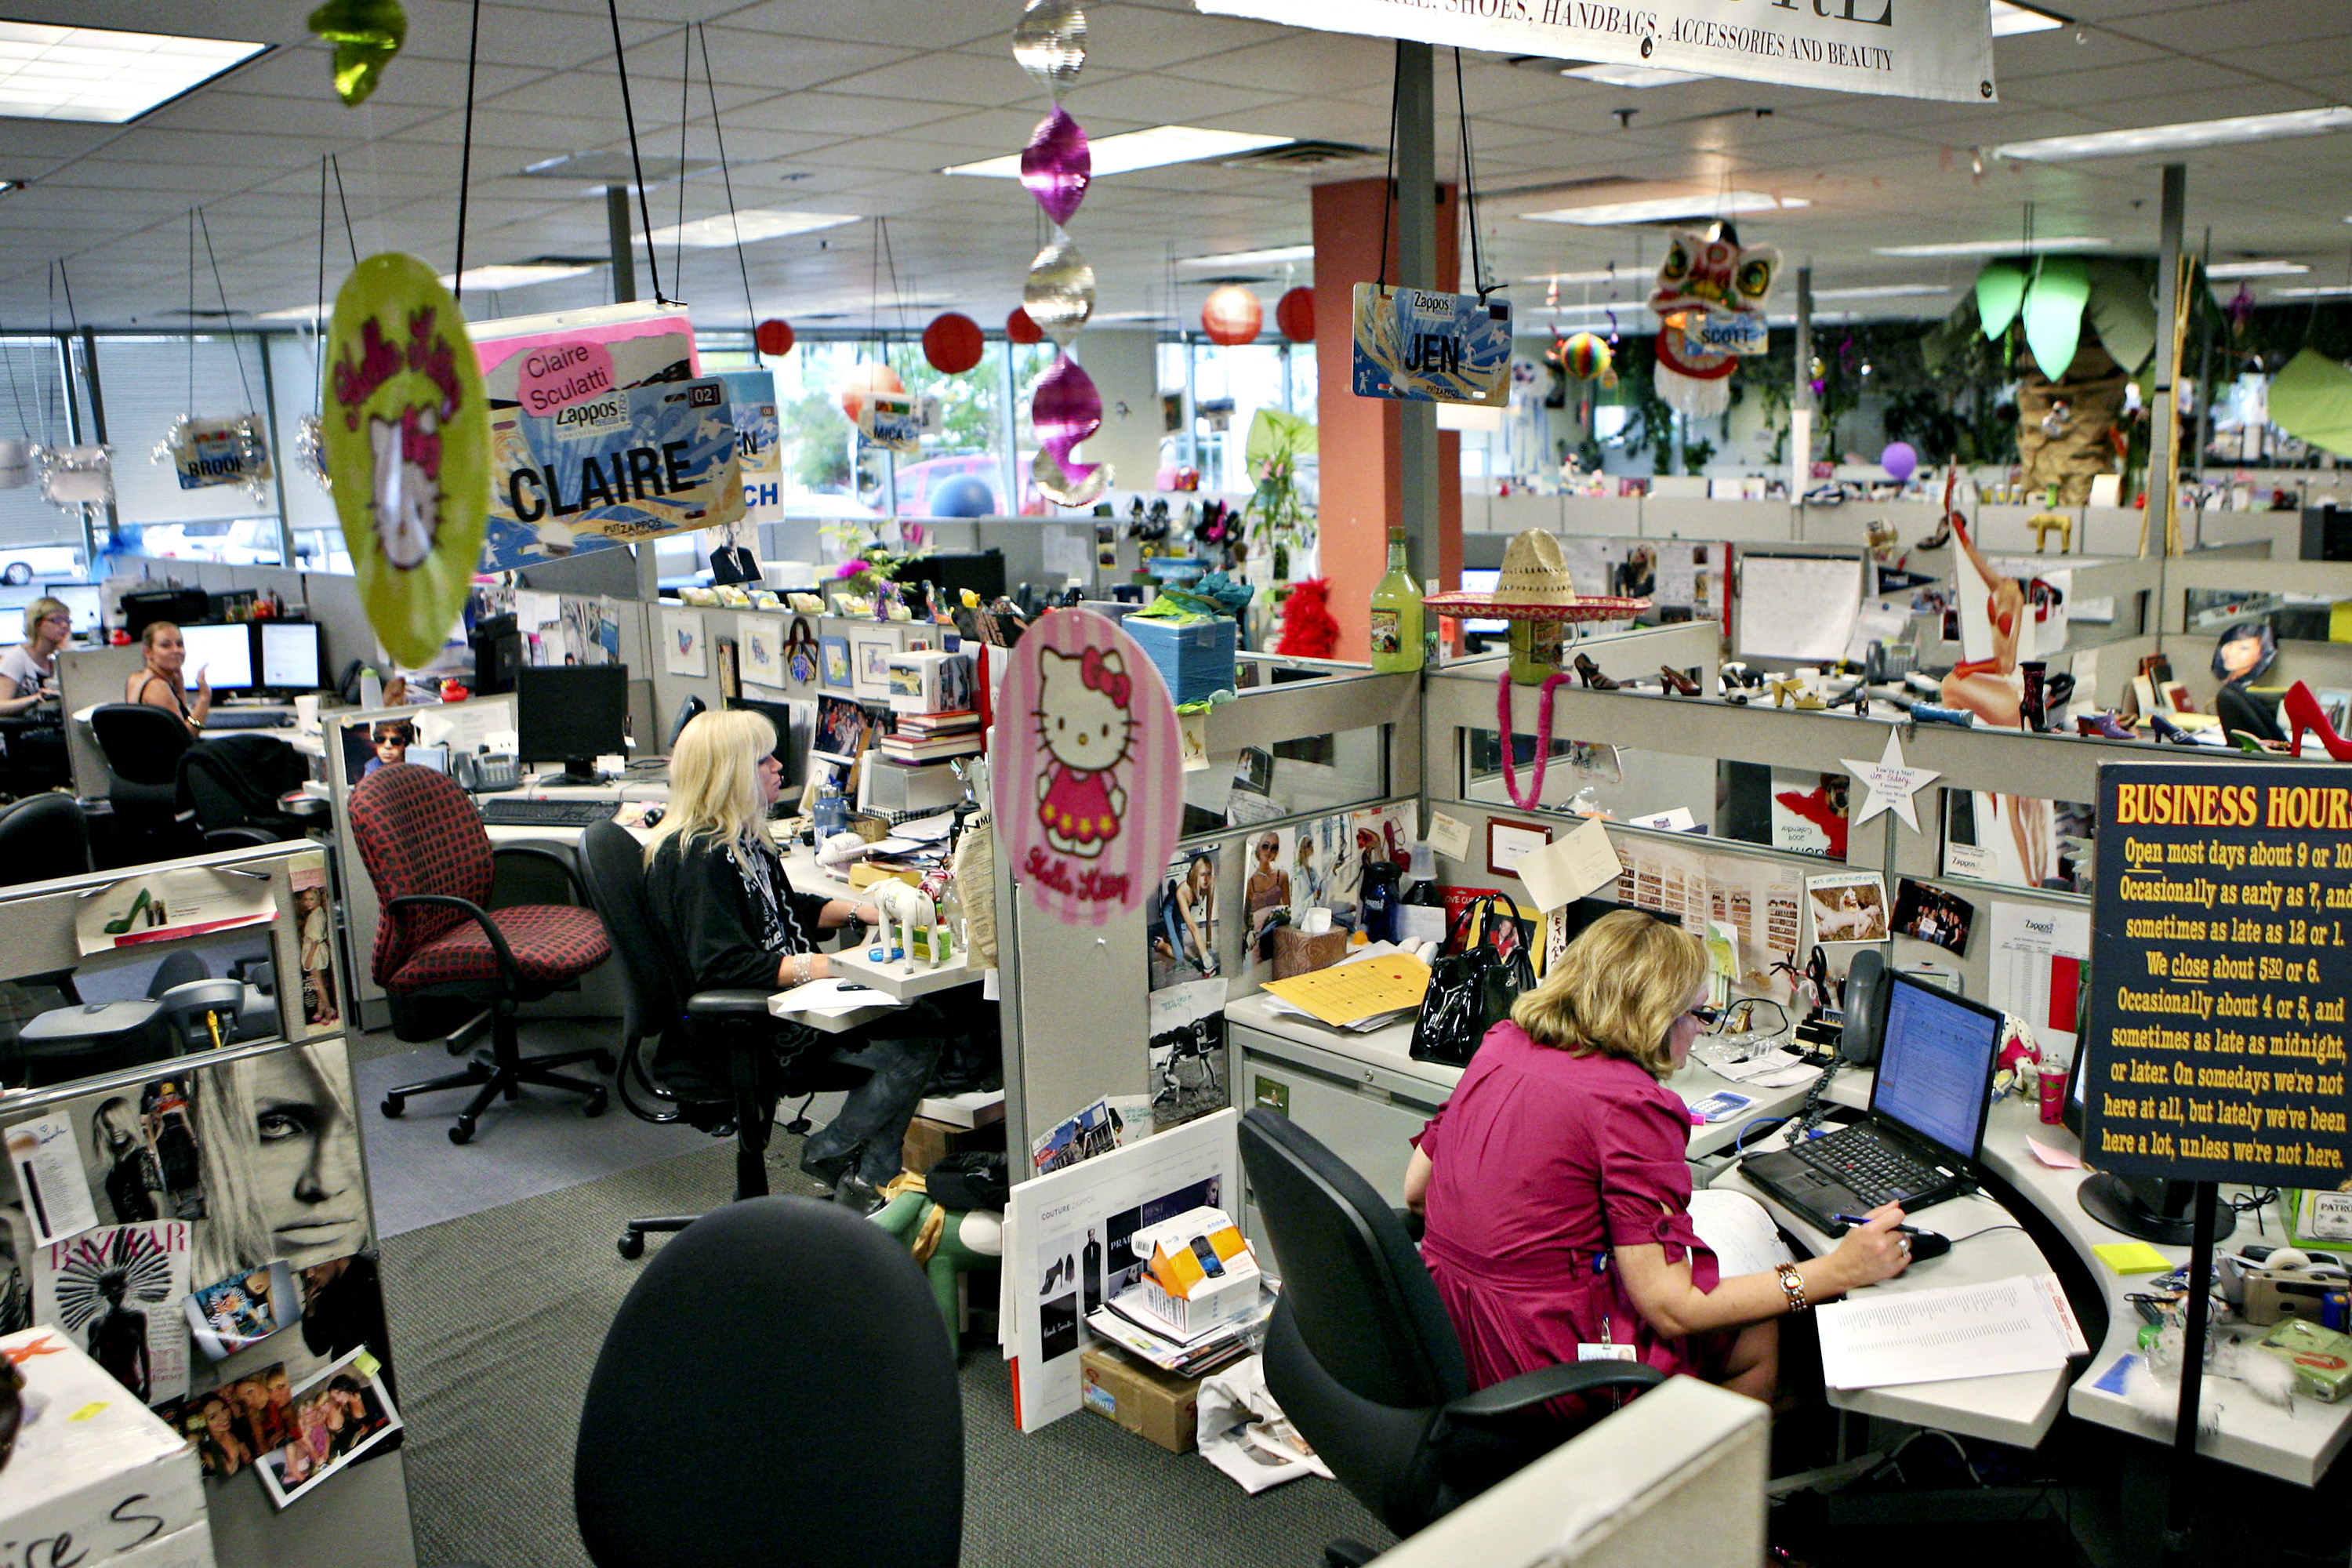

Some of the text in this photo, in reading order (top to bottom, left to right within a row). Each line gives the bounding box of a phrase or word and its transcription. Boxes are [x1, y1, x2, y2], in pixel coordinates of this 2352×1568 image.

[1541, 0, 1662, 45] HANDBAGS,
[1668, 16, 1786, 58] ACCESSORIES
[1789, 37, 1824, 63] AND
[1828, 42, 1894, 71] BEAUTY
[1414, 291, 1450, 313] Zappos
[1701, 328, 1751, 344] SCOTT
[527, 346, 589, 378] Claire
[1405, 332, 1460, 375] JEN
[531, 366, 608, 410] Sculatti
[695, 388, 713, 403] 02
[557, 401, 618, 427] Zappos
[509, 440, 696, 524] CLAIRE
[620, 517, 662, 534] ZAPPOS
[2117, 784, 2352, 829] BUSINESS HOUR
[1780, 826, 1813, 834] Calendar
[2125, 837, 2163, 869] Open
[2167, 842, 2205, 863] most
[2209, 840, 2246, 869] days
[2250, 842, 2293, 866] about
[2298, 843, 2308, 866] 9
[2313, 848, 2330, 867] or
[2120, 876, 2352, 913] Occasionally as early as 7, and
[2126, 915, 2344, 946] sometimes as late as 12 or 1.
[2147, 952, 2168, 975] We
[2172, 953, 2209, 977] close
[2213, 955, 2255, 979] about
[2287, 963, 2304, 982] or
[2307, 961, 2320, 982] 6.
[2118, 987, 2345, 1024] Occasionally about 4 or 5, and
[2112, 1025, 2347, 1065] sometimes as late as midnight,
[2111, 1059, 2343, 1094] or later. On somedays we're not
[2104, 1094, 2346, 1131] here at all, but lately we've been
[2102, 1129, 2343, 1167] here a lot, unless we're not here.
[1041, 1203, 1070, 1221] COUTURE
